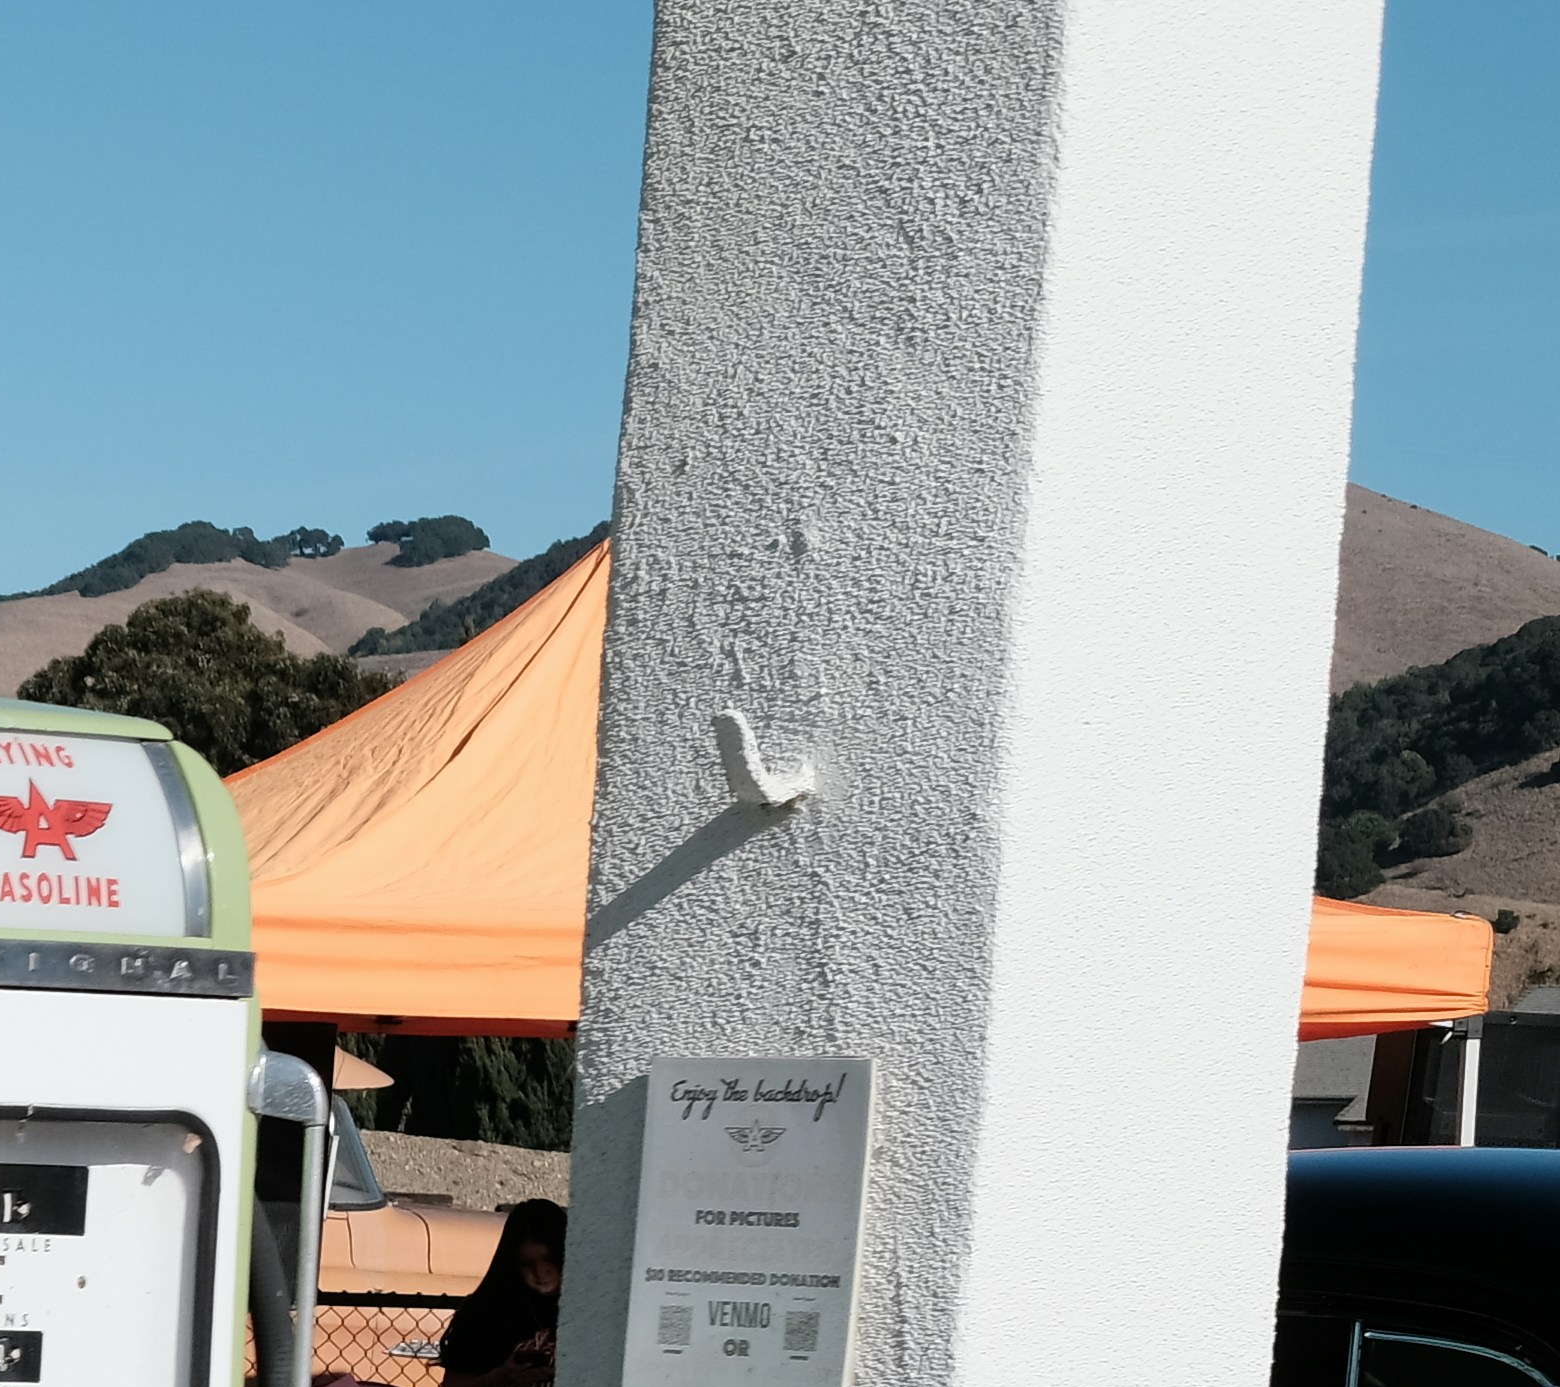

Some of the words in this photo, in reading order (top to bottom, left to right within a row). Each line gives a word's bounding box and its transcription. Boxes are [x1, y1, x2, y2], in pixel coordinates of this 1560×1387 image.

[671, 1079, 719, 1121] Enjoy
[753, 1072, 847, 1122] backdrop!
[695, 1209, 726, 1226] FOR
[729, 1210, 800, 1228] PICTURES
[3, 1238, 51, 1252] SALE
[667, 1269, 767, 1286] RECOMMENDED
[770, 1273, 841, 1288] DONATION
[708, 1300, 770, 1328] VENMO
[722, 1339, 751, 1357] OR
